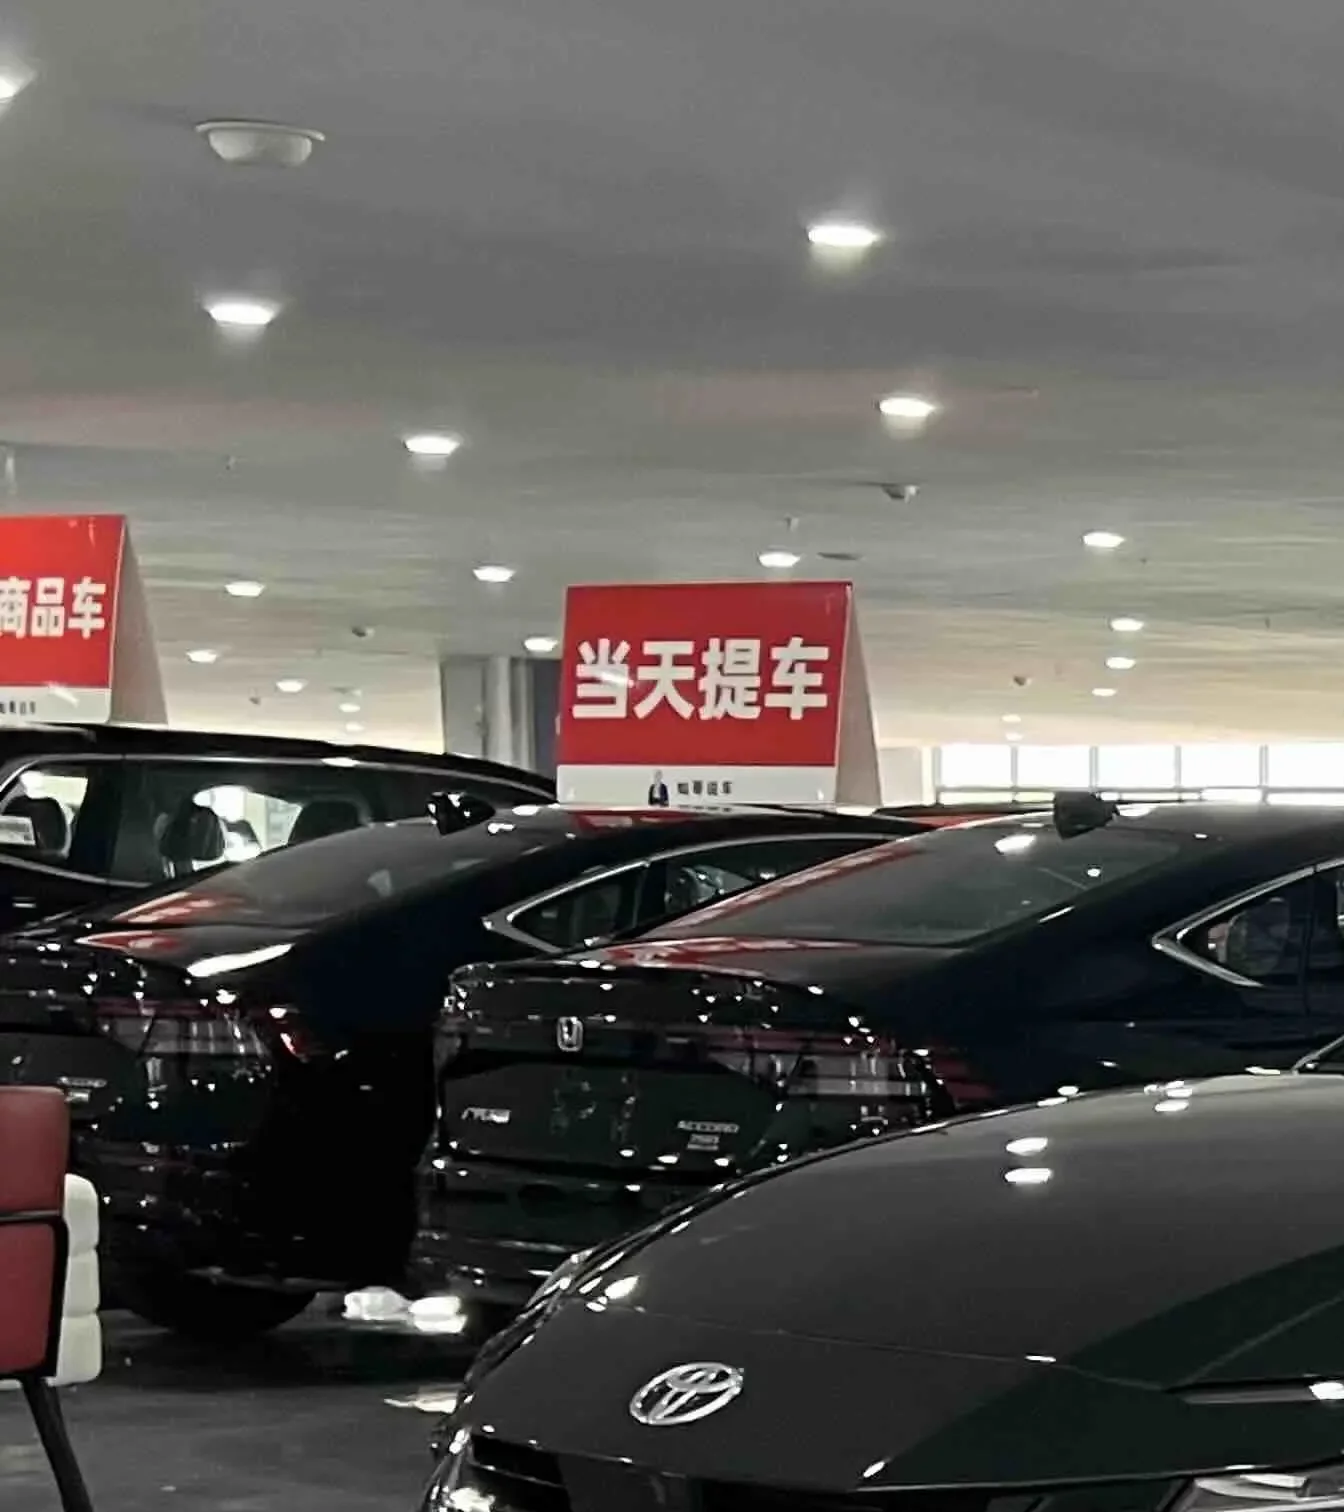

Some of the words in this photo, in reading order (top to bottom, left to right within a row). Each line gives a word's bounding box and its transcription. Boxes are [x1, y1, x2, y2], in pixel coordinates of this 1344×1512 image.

[0, 576, 107, 640] 商品车
[572, 636, 830, 721] 当天提车
